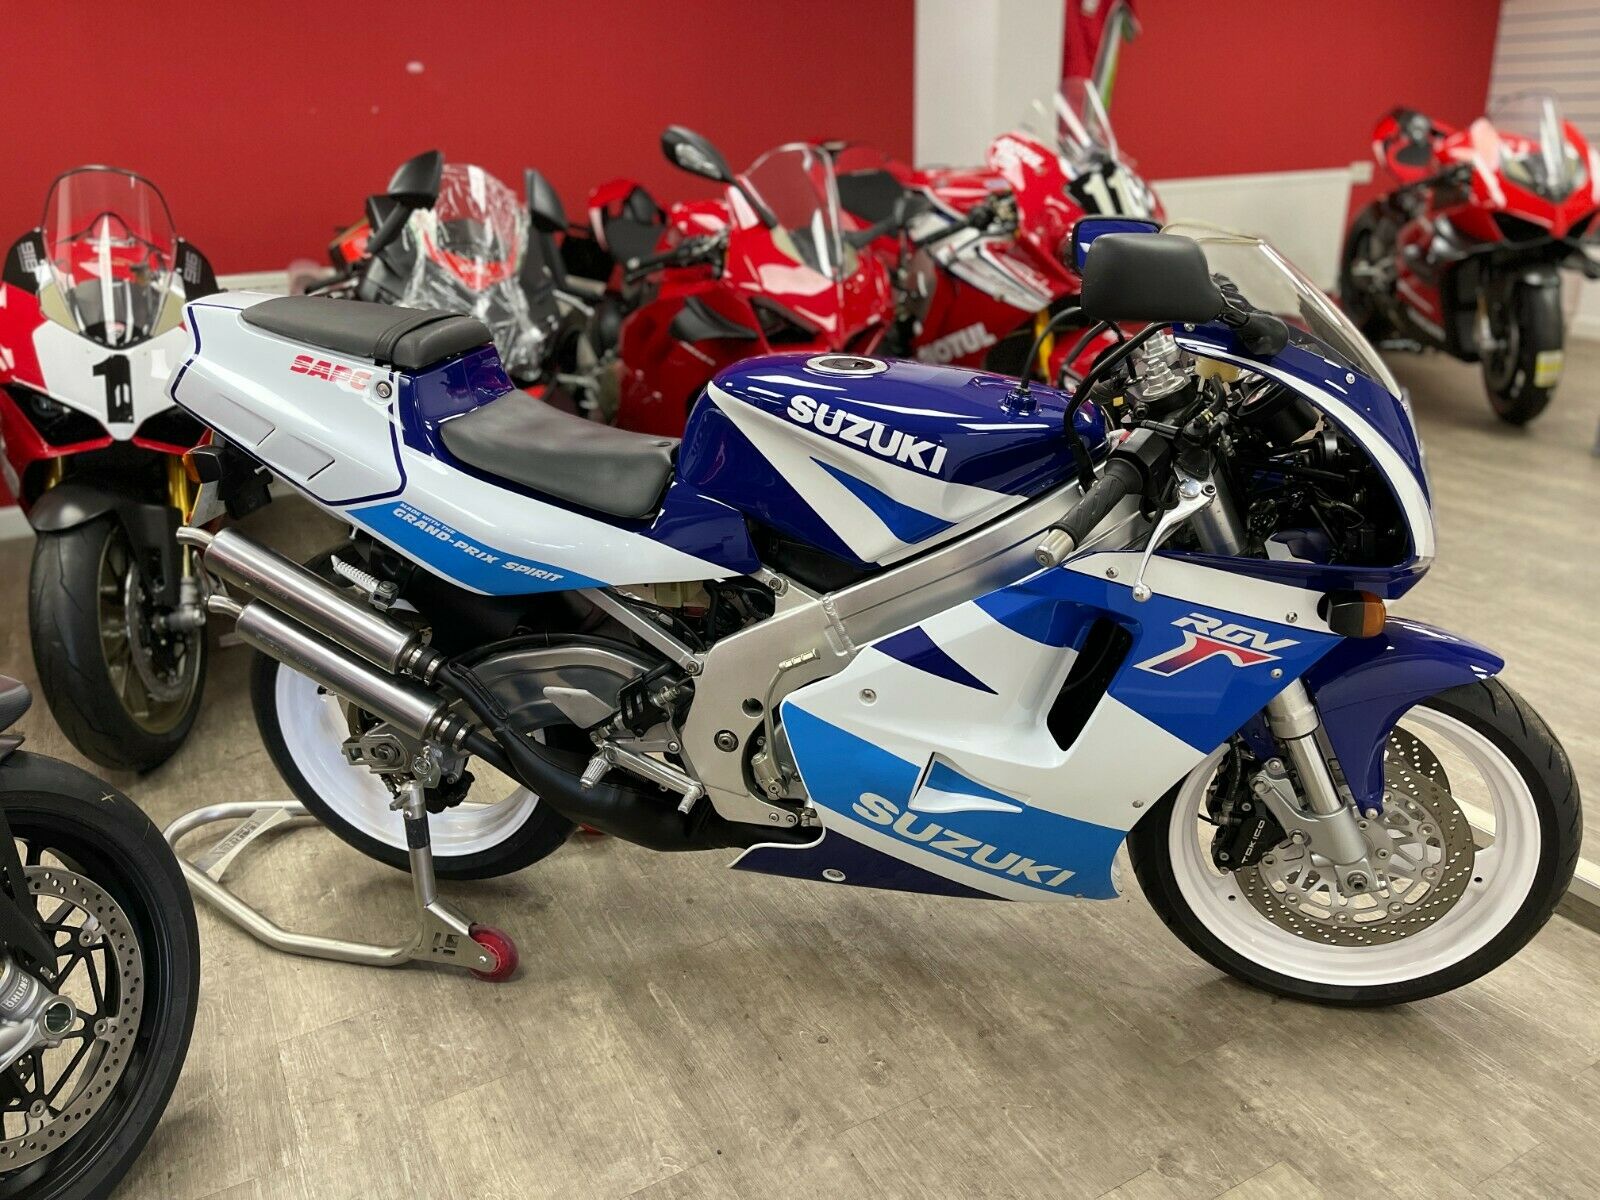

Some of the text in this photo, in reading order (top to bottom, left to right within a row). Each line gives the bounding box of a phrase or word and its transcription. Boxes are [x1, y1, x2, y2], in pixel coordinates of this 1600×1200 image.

[92, 354, 135, 424] 1
[786, 394, 948, 475] SUZUKI
[392, 507, 565, 583] GRAND-PRIX SPIRIT
[400, 502, 457, 535] MADE WITH THE
[1170, 612, 1302, 652] RGV
[852, 792, 1076, 887] SUZUKI
[1241, 820, 1266, 864] TOKICO
